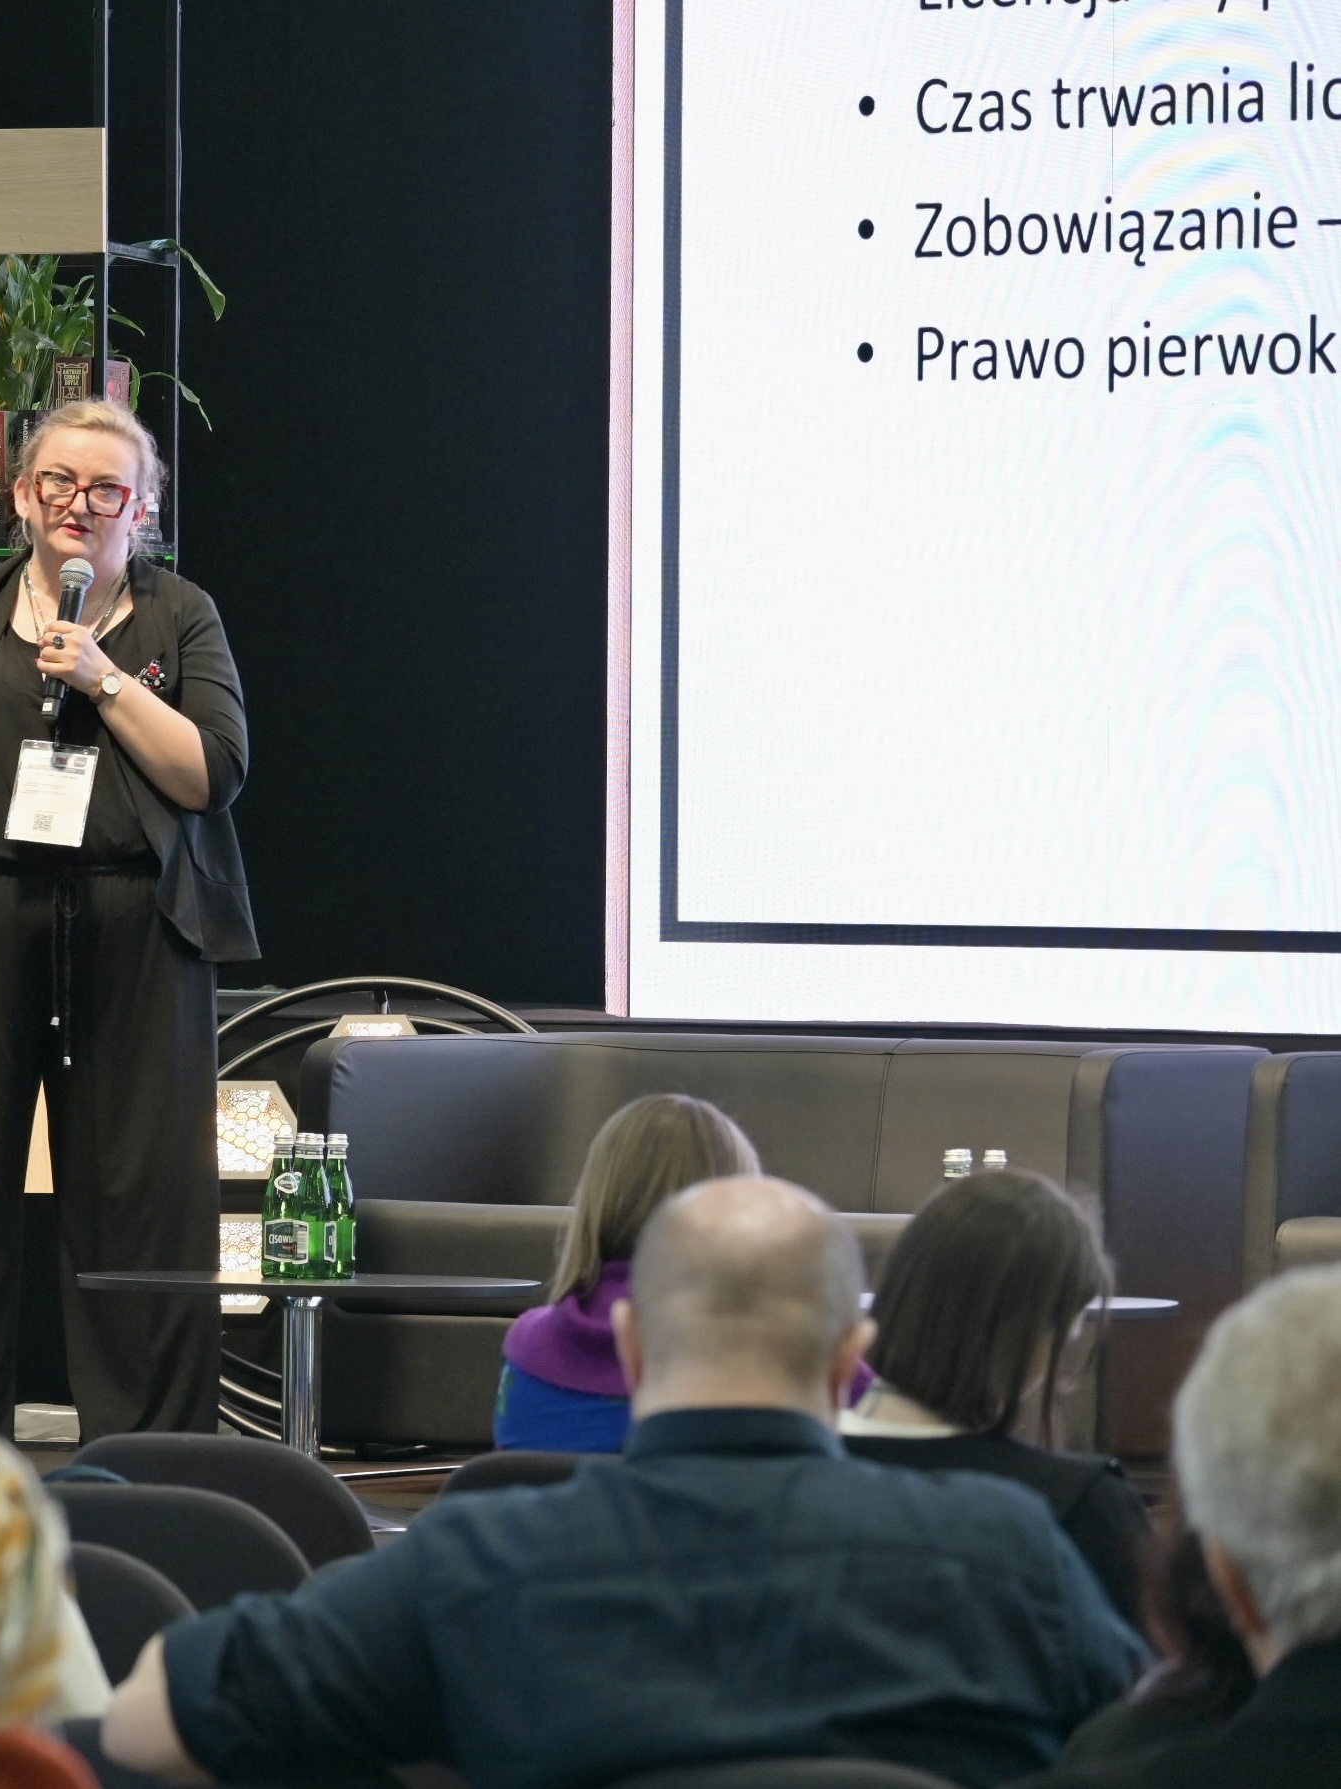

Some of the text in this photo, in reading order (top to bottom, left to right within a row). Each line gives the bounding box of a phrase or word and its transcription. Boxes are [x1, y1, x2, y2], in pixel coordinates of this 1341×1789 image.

[915, 78, 1033, 134] Czas
[1052, 66, 1265, 128] trwania
[914, 190, 1299, 267] Zobowiązanie
[916, 314, 1339, 394] Prawo pierwok
[268, 1233, 295, 1244] CISOWI
